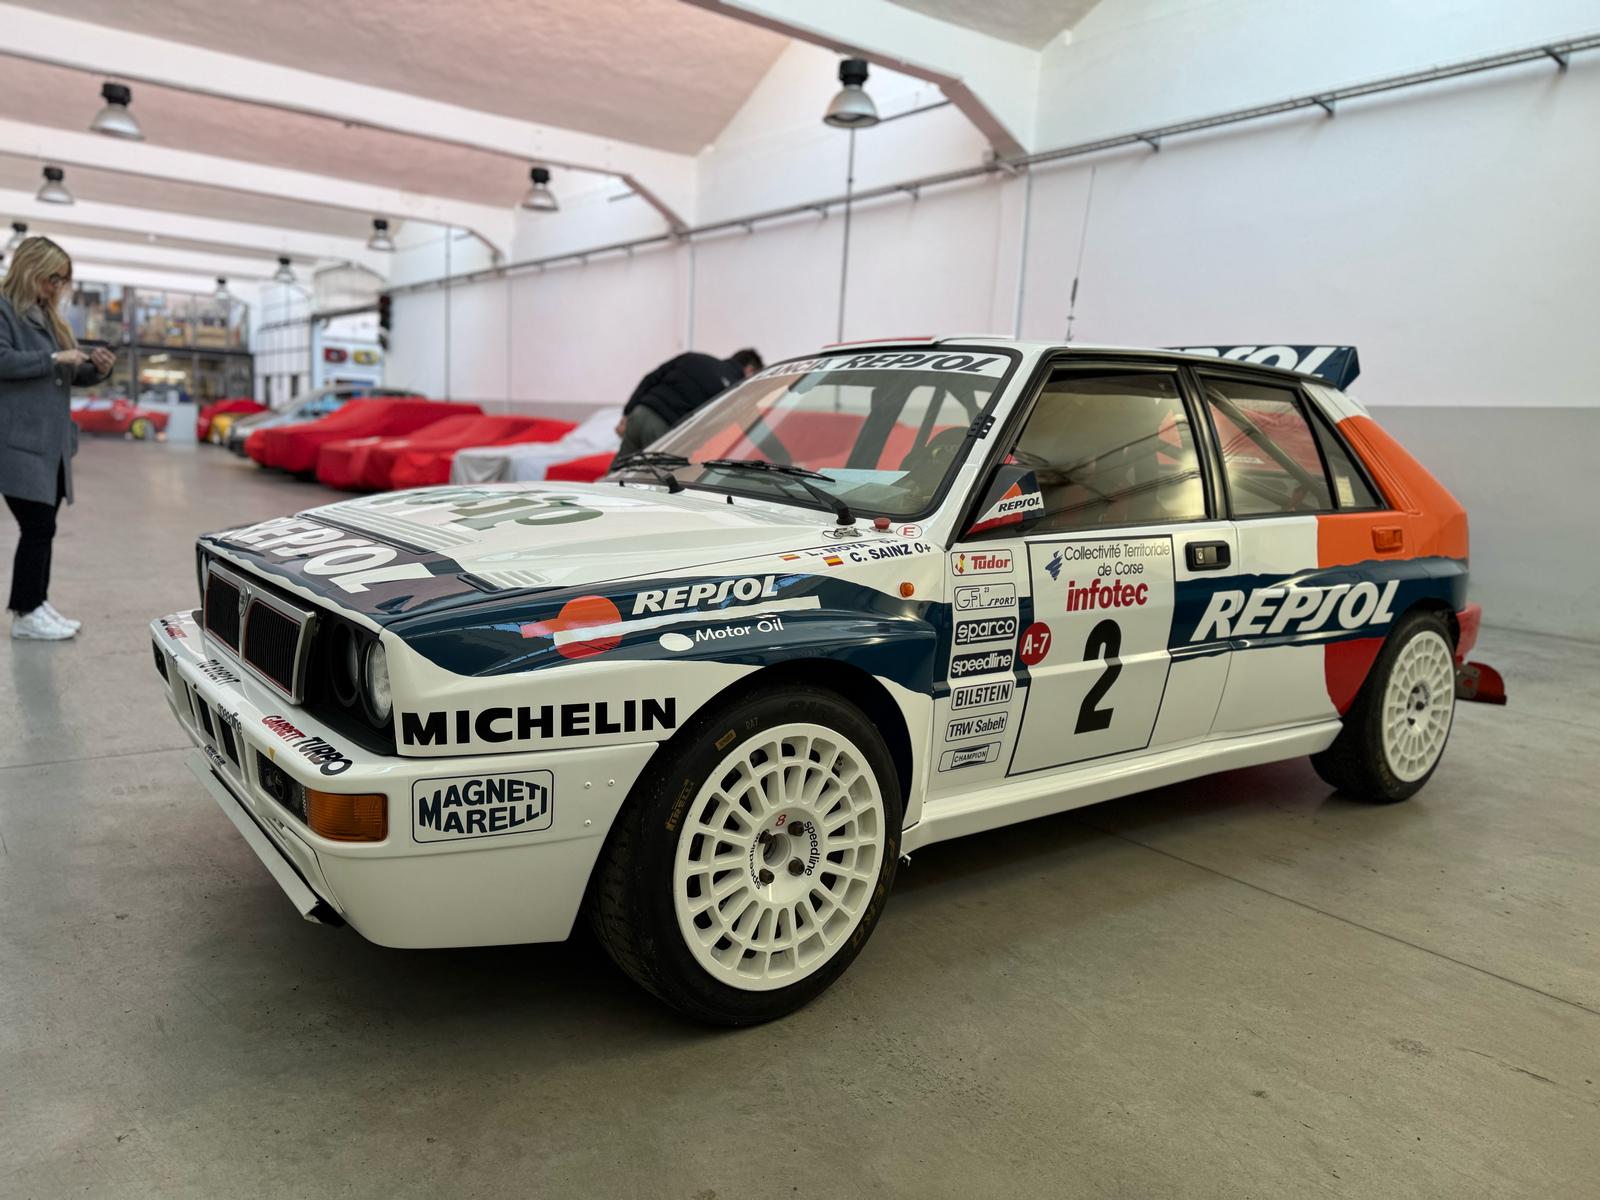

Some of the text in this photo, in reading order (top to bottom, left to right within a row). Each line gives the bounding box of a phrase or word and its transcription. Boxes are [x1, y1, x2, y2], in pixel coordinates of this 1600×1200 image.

[836, 353, 1000, 373] REPSOL
[998, 496, 1041, 513] REPSOL
[903, 526, 916, 537] E
[868, 543, 913, 560] SAINZ
[971, 554, 1011, 570] Tudor
[1064, 542, 1171, 561] Collectivité Territoriale
[1097, 561, 1144, 577] de Corse
[632, 575, 780, 615] REPSOL
[1066, 579, 1149, 612] infotec
[1190, 579, 1400, 642] REPSOL
[695, 617, 784, 643] Motor Oil
[957, 619, 1015, 643] sparco
[1021, 632, 1050, 656] A-7
[951, 652, 1012, 676] speedline
[1074, 618, 1123, 735] 2
[955, 683, 1011, 707] BILSTEIN
[401, 697, 676, 746] MICHELIN
[949, 716, 1005, 738] TRW Sabelt
[292, 736, 354, 776] TURBO
[953, 750, 987, 763] CHAMPION
[418, 778, 548, 818] MAGNETI
[418, 798, 548, 834] MARELLI
[775, 813, 787, 827] 8
[804, 820, 821, 877] speedline
